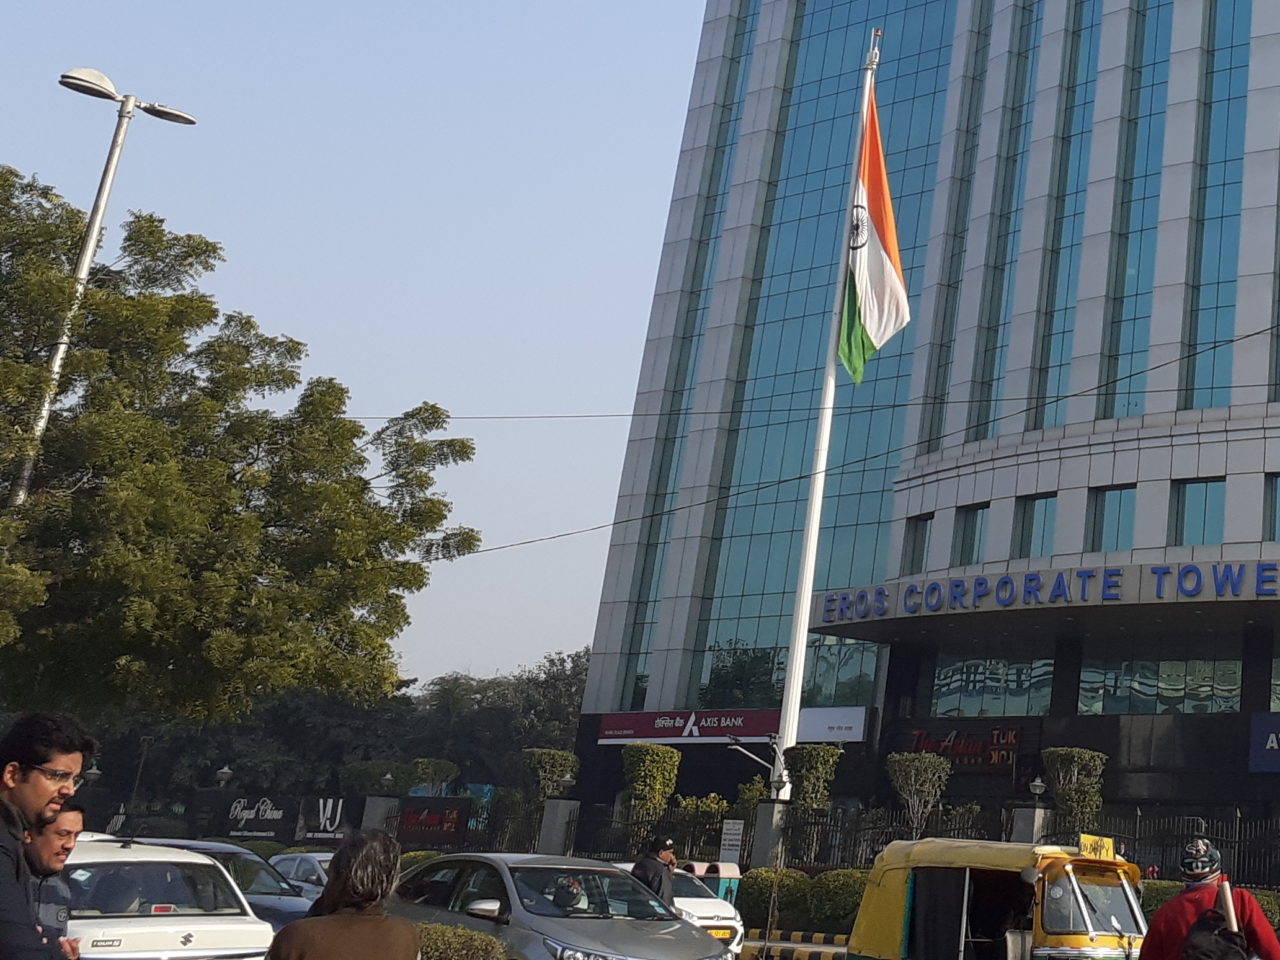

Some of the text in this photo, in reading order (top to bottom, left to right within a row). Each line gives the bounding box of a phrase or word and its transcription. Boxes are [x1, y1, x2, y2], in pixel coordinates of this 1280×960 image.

[821, 587, 889, 623] EROS
[903, 568, 1123, 615] CORPORATE
[700, 716, 744, 727] AXIS BANK
[229, 797, 284, 828] Royal China
